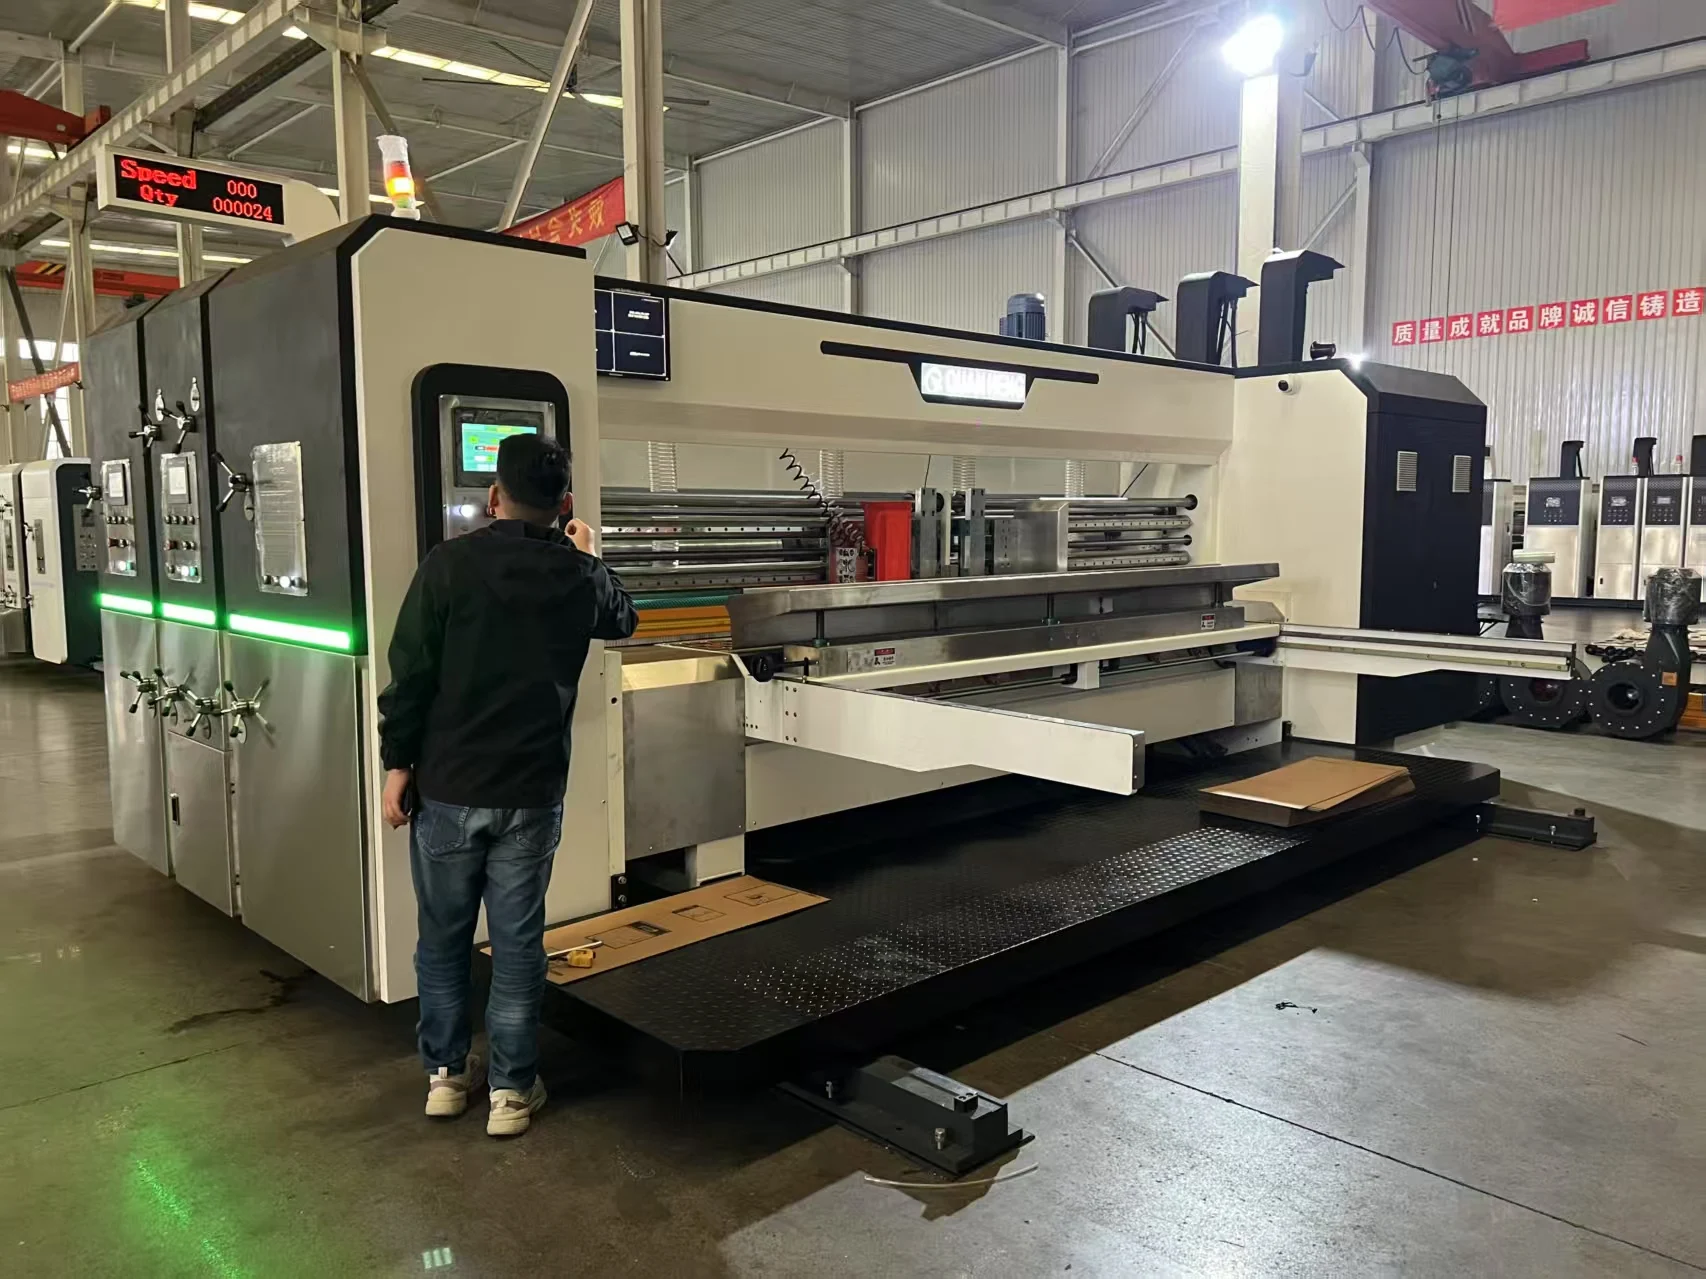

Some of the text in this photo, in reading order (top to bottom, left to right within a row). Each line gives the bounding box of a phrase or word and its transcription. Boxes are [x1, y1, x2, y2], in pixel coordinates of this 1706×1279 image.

[120, 159, 257, 199] Speed 000
[140, 184, 273, 221] Qty 000024
[1394, 290, 1701, 344] 质量成就品牌诚信铸造
